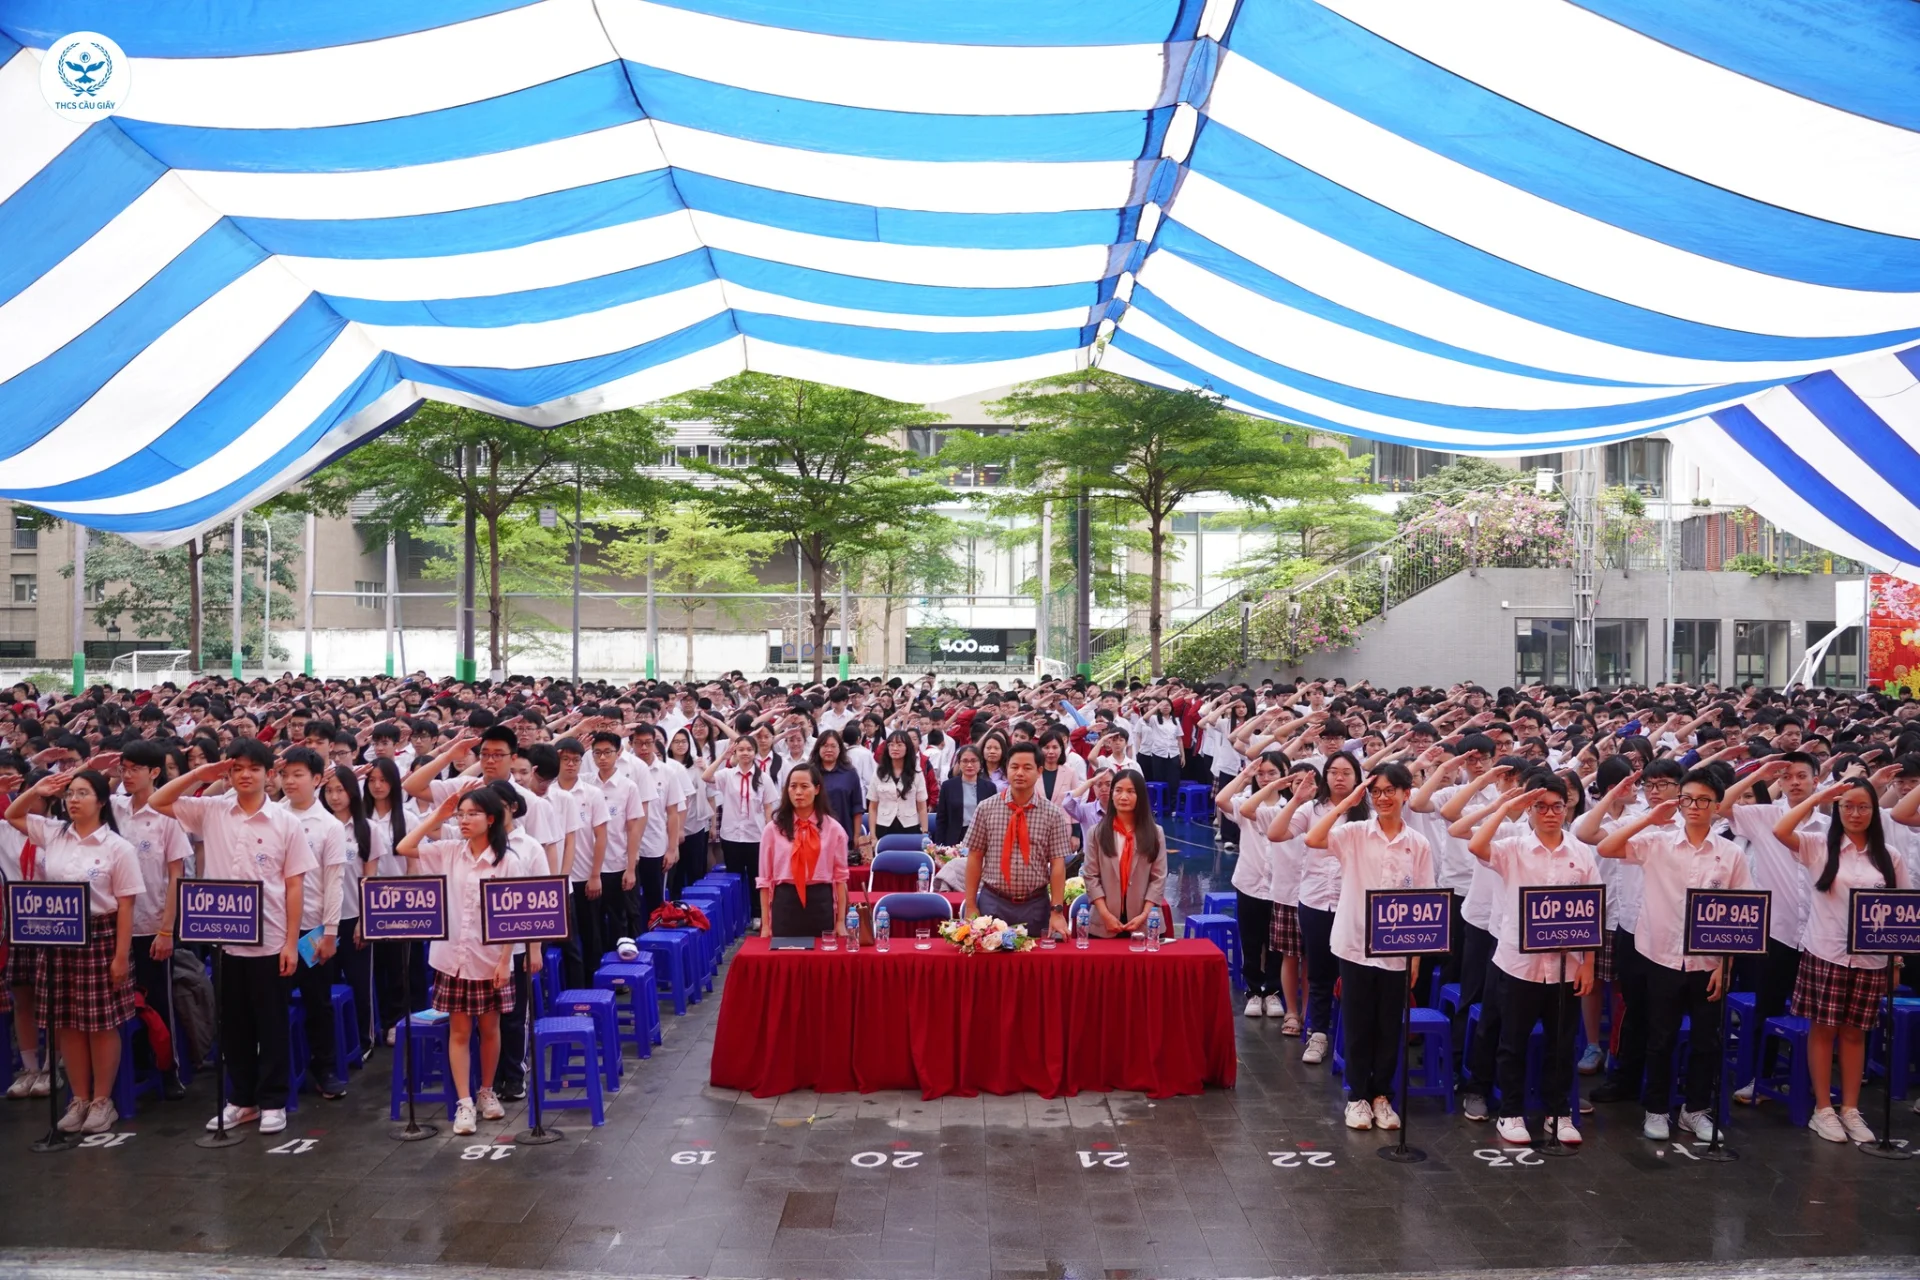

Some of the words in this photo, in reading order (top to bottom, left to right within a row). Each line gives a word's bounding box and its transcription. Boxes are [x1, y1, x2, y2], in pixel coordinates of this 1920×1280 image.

[16, 890, 42, 914] LỚP
[46, 896, 79, 915] 9A11
[187, 888, 215, 912] LỚP
[217, 894, 253, 914] 9A10
[405, 890, 436, 909] 9A9
[492, 887, 523, 911] LỚP
[527, 890, 559, 910] 9A8
[1532, 895, 1561, 920] LỚP
[1565, 899, 1595, 918] 9A6
[1378, 899, 1409, 923] LỚP
[1412, 903, 1442, 922] 9A7
[1697, 898, 1727, 922] LỚP
[1730, 904, 1760, 924] 9A5
[20, 925, 51, 935] CLASS
[53, 925, 77, 936] 9A11
[189, 922, 222, 933] CLASS
[223, 923, 250, 934] 9A10
[376, 920, 408, 930] CLASS
[412, 919, 432, 929] 9A9
[498, 922, 532, 932] CLASS
[534, 921, 555, 930] 9A8
[1383, 934, 1416, 944] CLASS
[1418, 933, 1438, 943] 9A7
[1536, 930, 1568, 941] CLASS
[1569, 929, 1591, 939] 9A6
[1700, 933, 1733, 943] CLASS
[1733, 934, 1754, 944] 9A5
[1865, 933, 1898, 943] CLASS
[1900, 933, 1920, 943] 9A4
[78, 1131, 137, 1149] 16
[266, 1138, 320, 1154] 17
[460, 1143, 518, 1161] 18
[669, 1149, 717, 1166] 19
[850, 1150, 924, 1169] 20
[1075, 1150, 1131, 1169] 21
[1267, 1150, 1337, 1168] 22
[1472, 1147, 1546, 1167] 23
